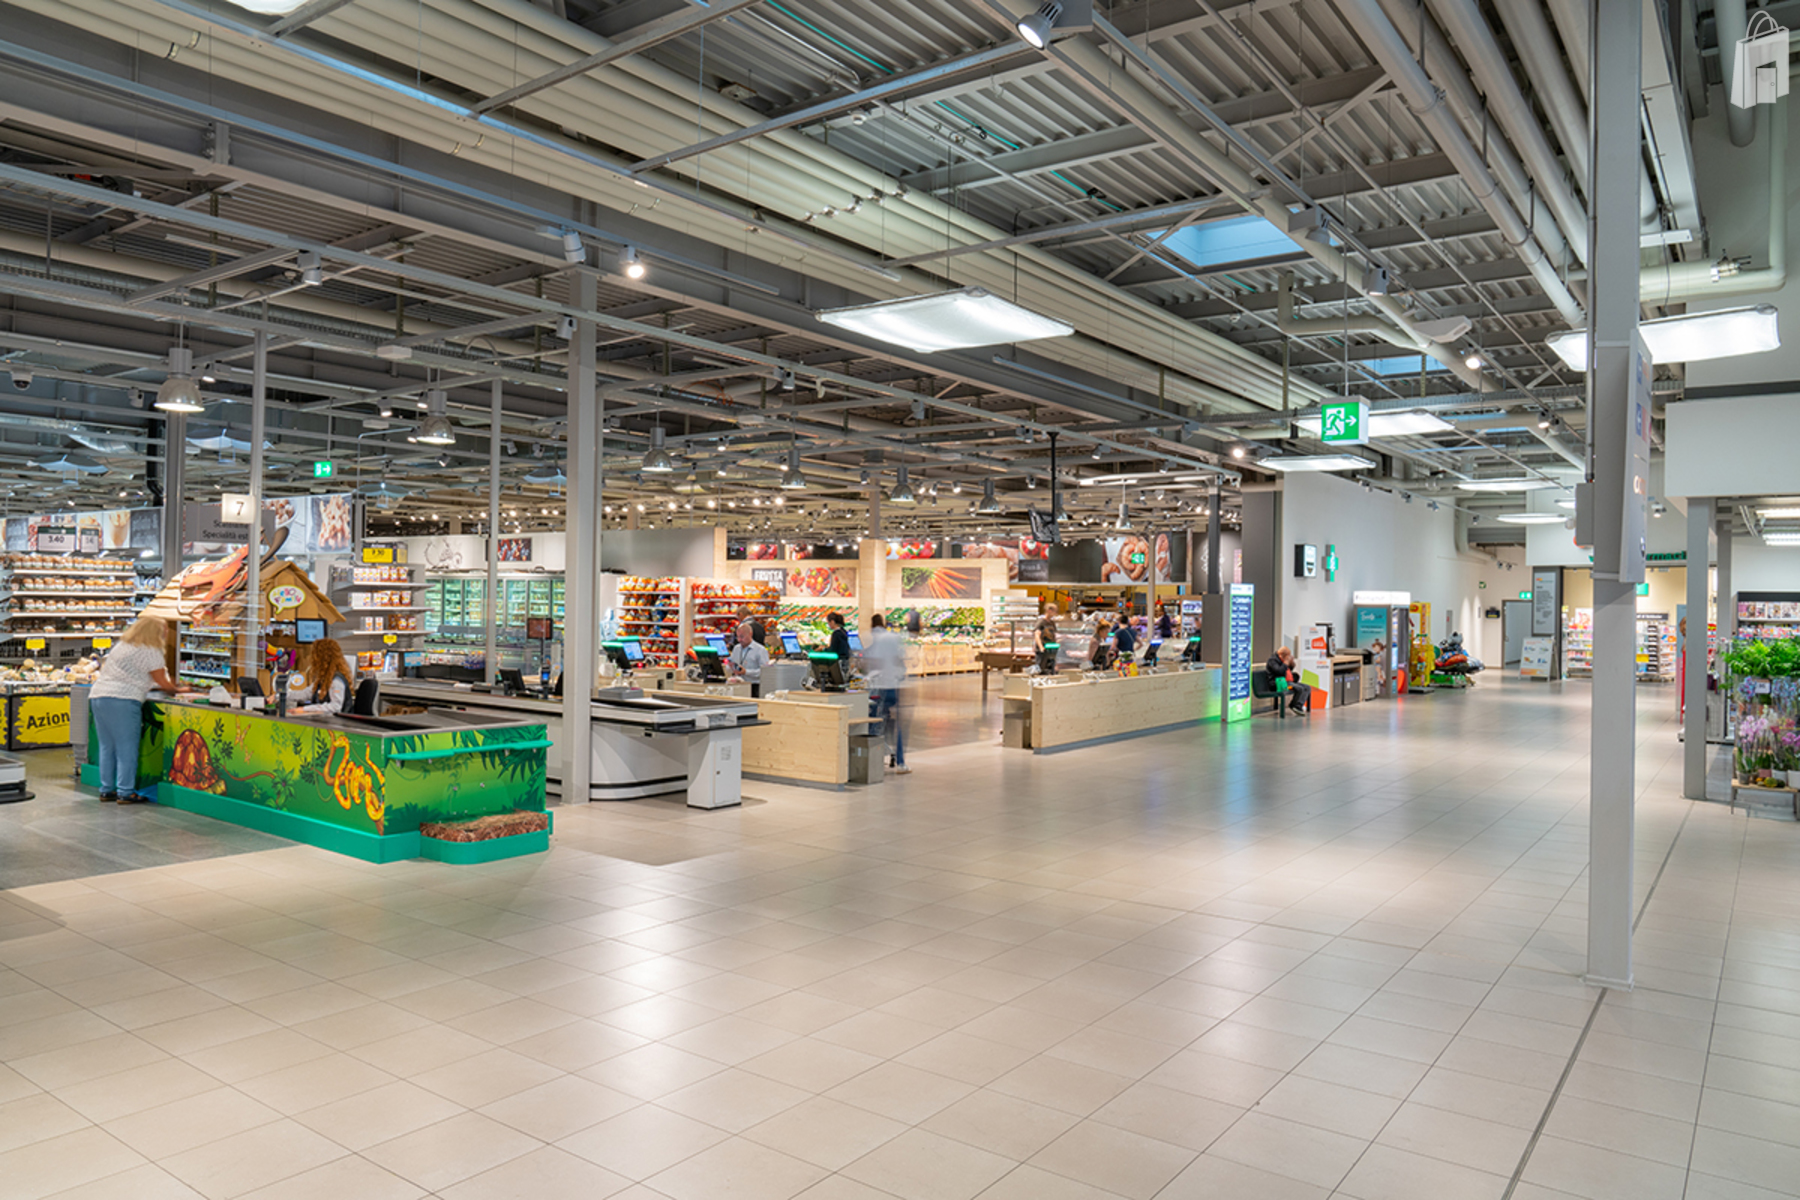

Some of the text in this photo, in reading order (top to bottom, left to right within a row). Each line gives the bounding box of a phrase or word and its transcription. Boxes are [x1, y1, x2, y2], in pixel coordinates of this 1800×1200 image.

[236, 501, 244, 516] 7
[202, 529, 236, 539] Specialità
[755, 570, 784, 580] FRUTTA
[27, 712, 70, 730] Azion
